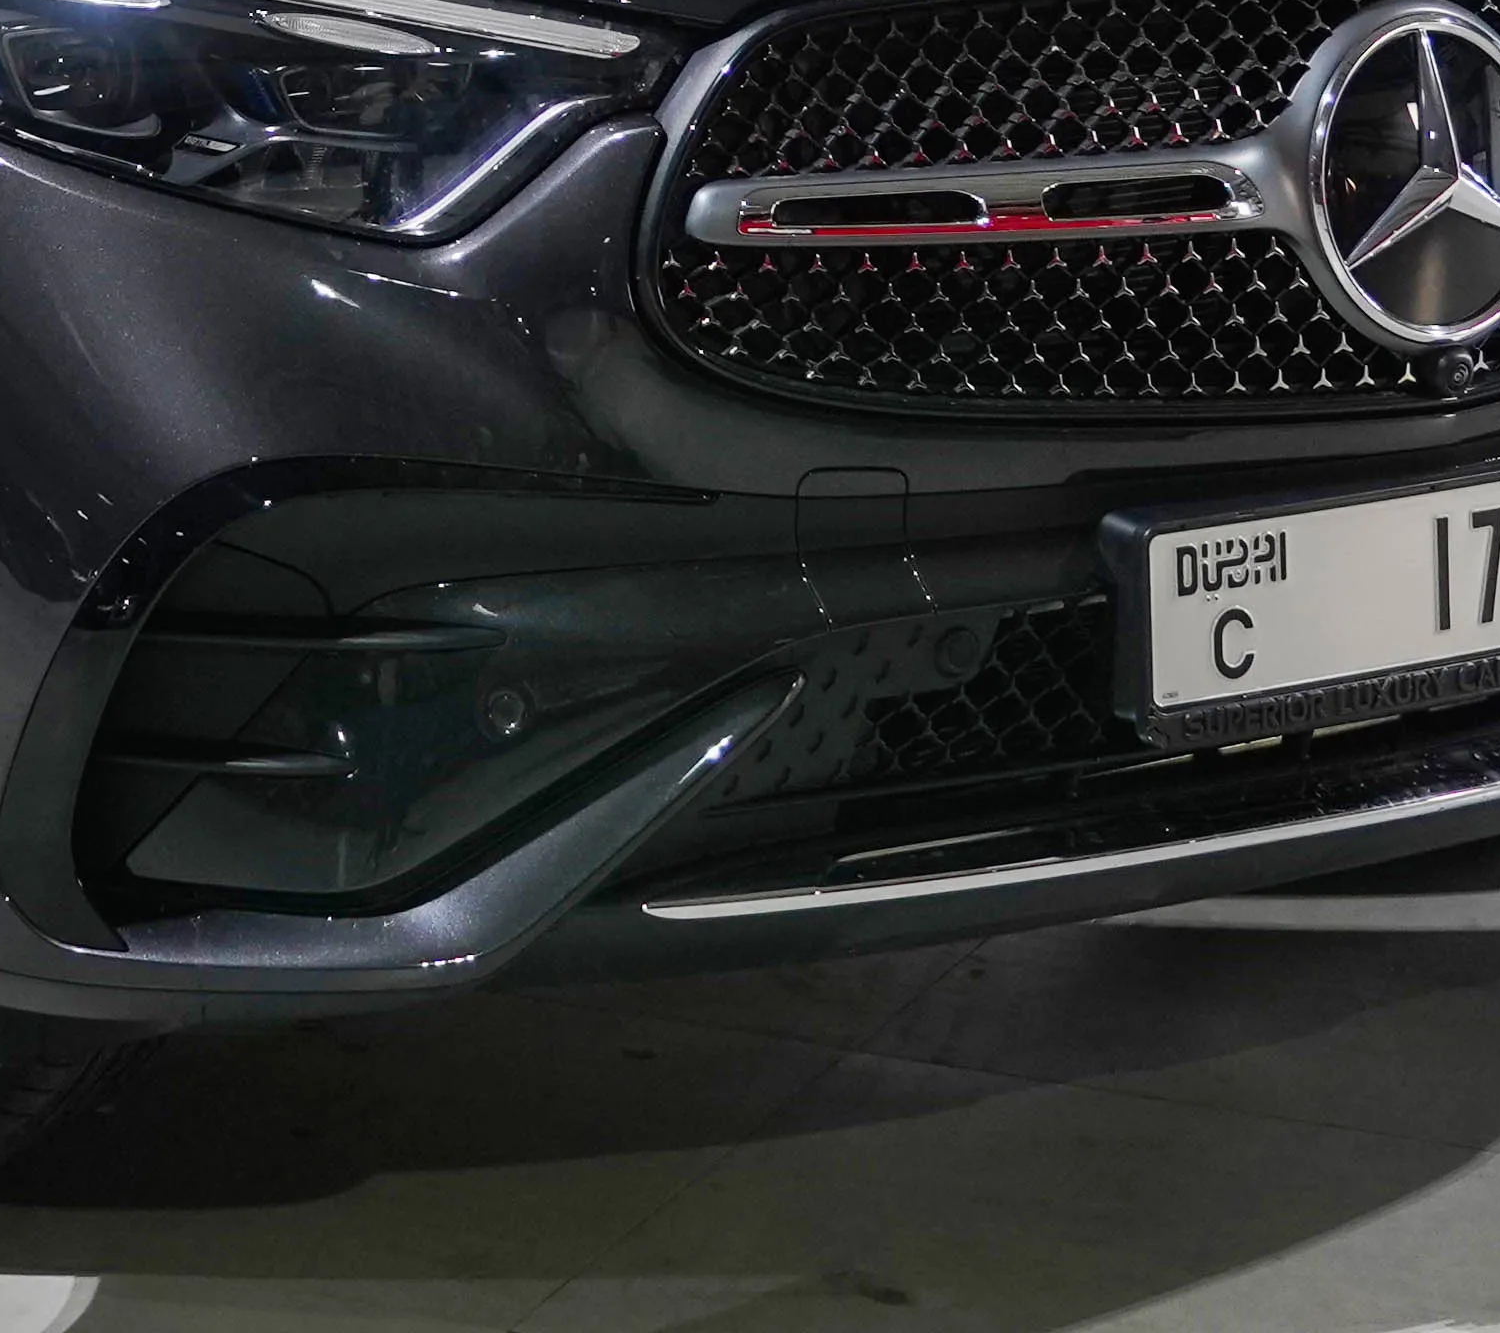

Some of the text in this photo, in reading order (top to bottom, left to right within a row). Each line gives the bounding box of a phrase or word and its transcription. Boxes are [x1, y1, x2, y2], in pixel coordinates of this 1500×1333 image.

[1213, 608, 1255, 680] C
[1183, 688, 1329, 743] SUPERIOR
[1338, 669, 1445, 716] LUXURY
